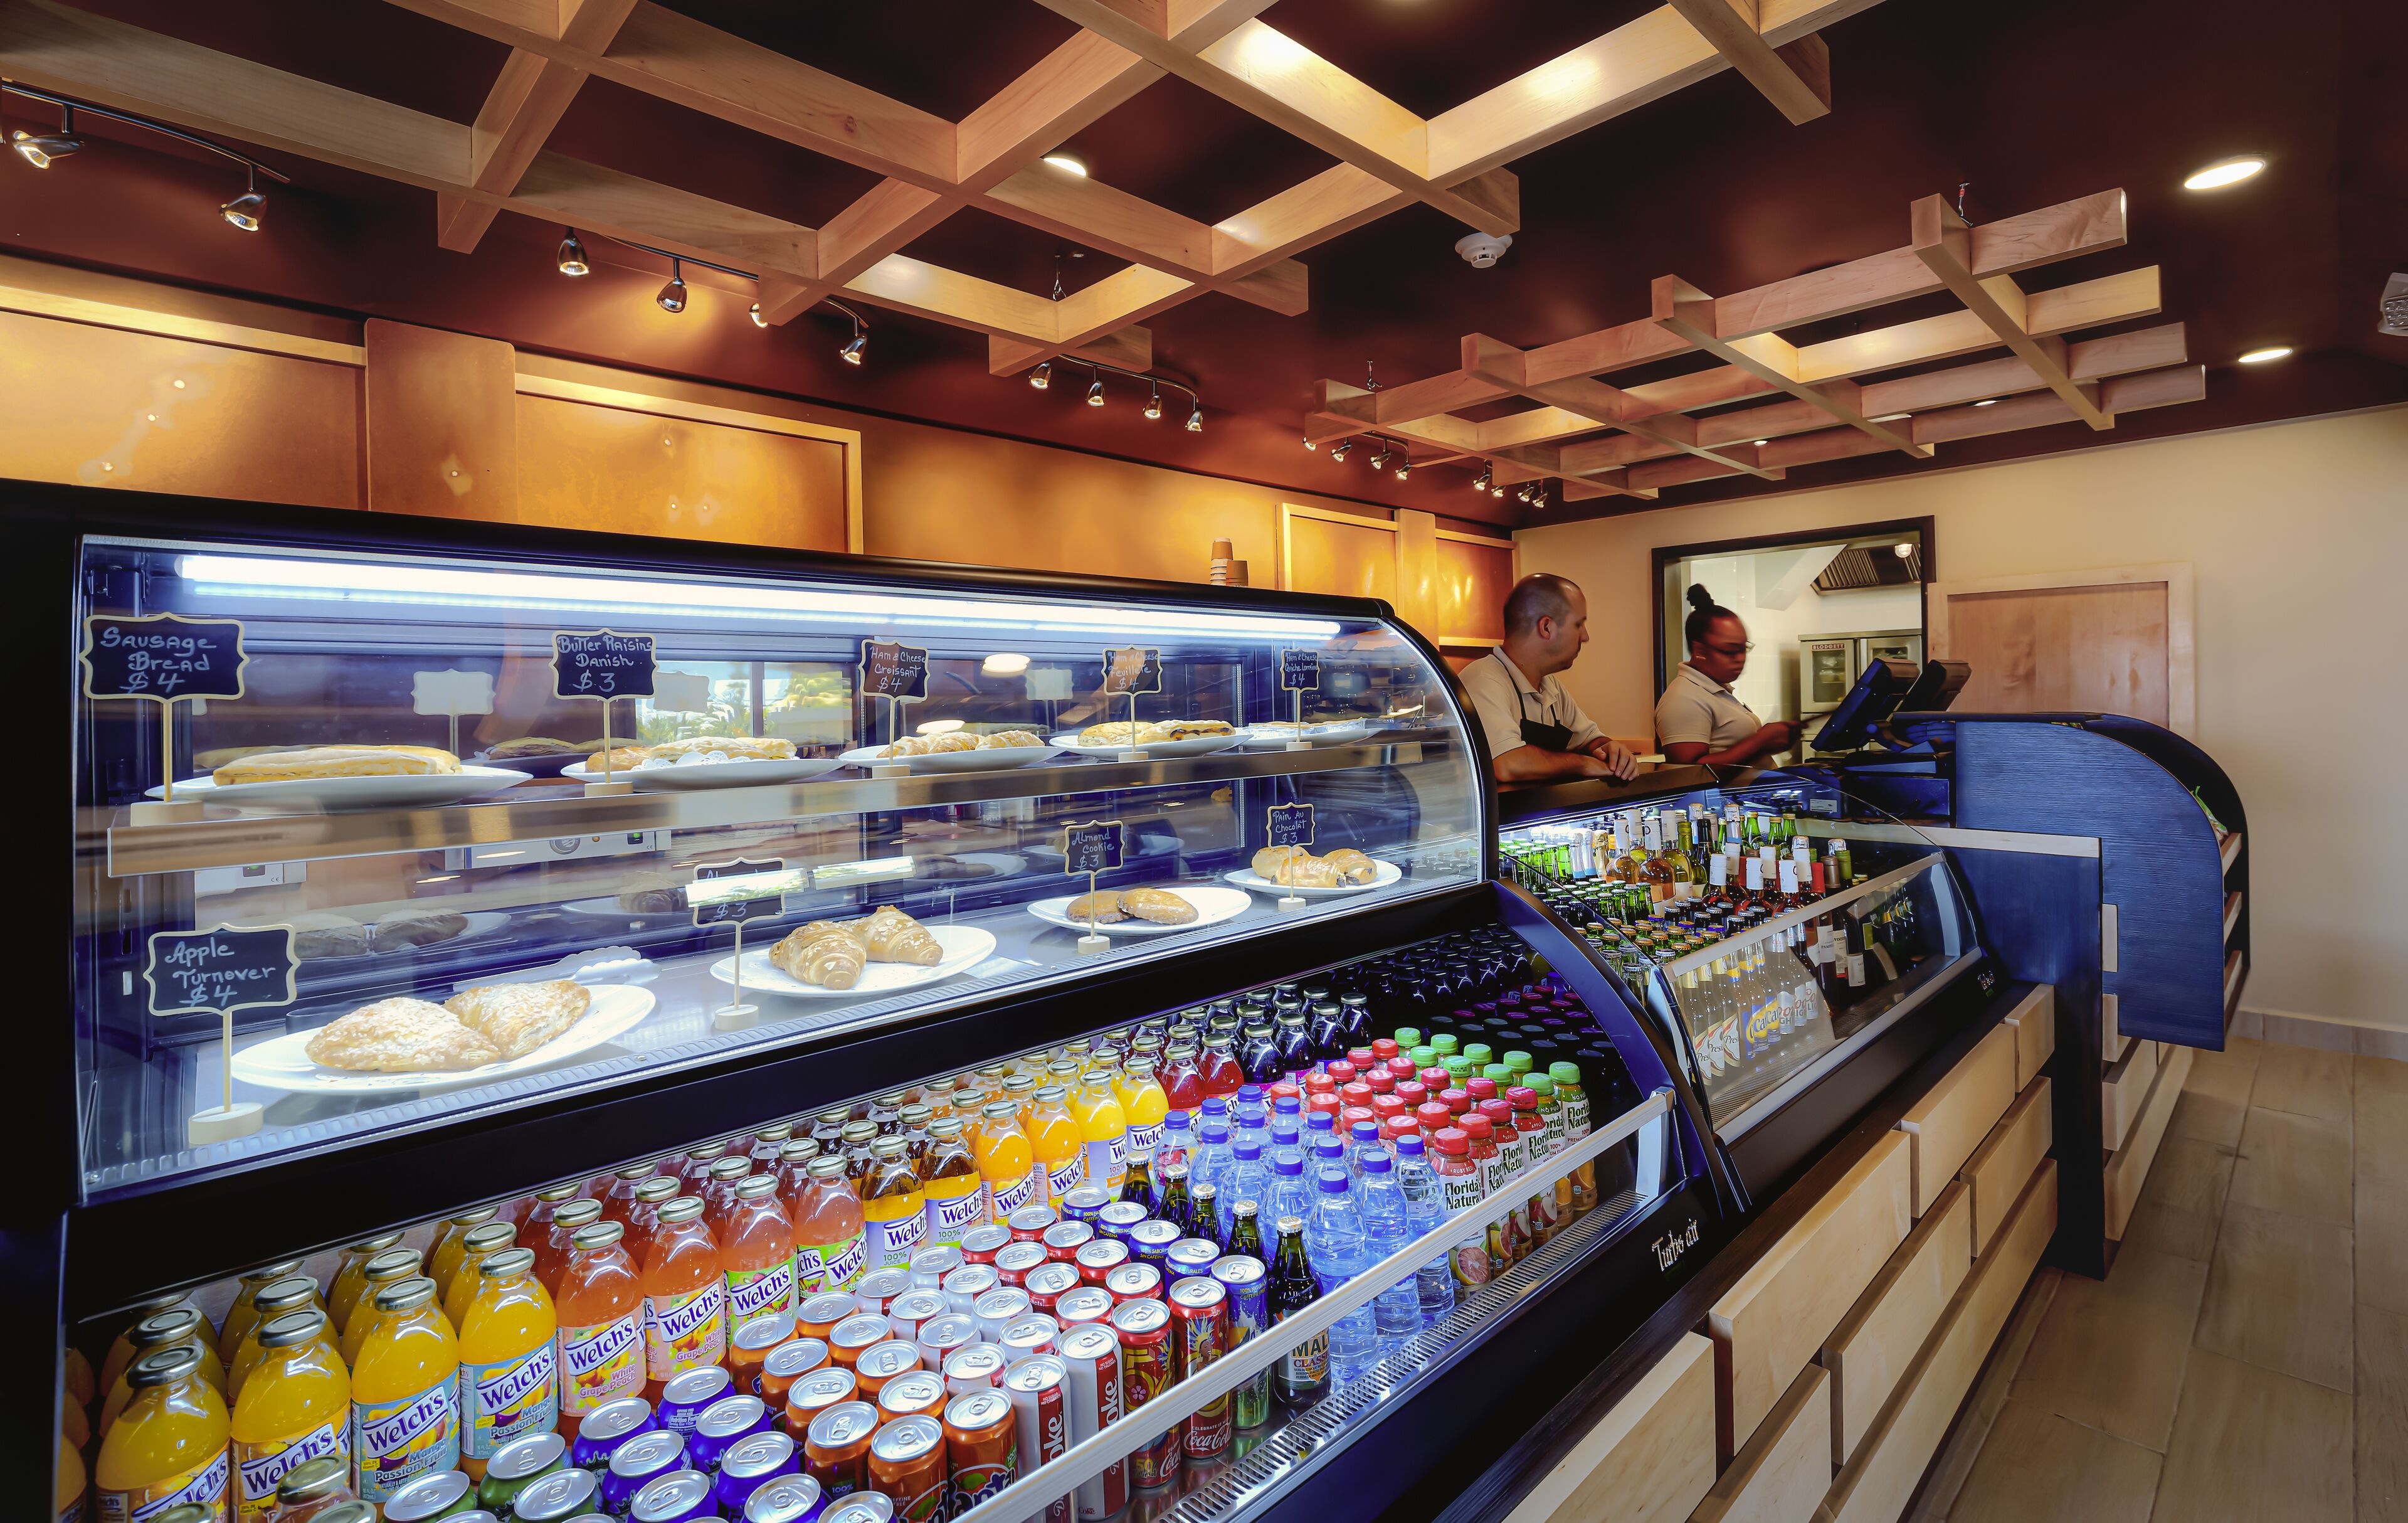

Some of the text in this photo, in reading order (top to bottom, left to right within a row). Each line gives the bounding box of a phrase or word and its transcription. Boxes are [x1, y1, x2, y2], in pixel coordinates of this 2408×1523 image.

[100, 626, 217, 656] Sausage
[602, 635, 652, 652] Raisins
[128, 651, 210, 672] Bread
[576, 653, 634, 667] Danish
[870, 647, 890, 660] Ham
[900, 651, 926, 663] Cheese
[1107, 652, 1127, 662] Ham
[874, 663, 921, 677] Croissant
[1272, 811, 1292, 823] Pain
[1275, 819, 1307, 833] Chocolat
[1071, 827, 1111, 846] Almond
[1082, 842, 1114, 854] Cookie
[164, 937, 235, 967] Apple
[172, 967, 277, 989] Turnover
[939, 1229, 961, 1239] 100%
[884, 1251, 907, 1261] 100%
[734, 1270, 789, 1311] Welch's
[662, 1289, 719, 1336] Welch's
[568, 1323, 633, 1370] Welch's
[677, 1347, 704, 1362] Grape
[480, 1352, 550, 1409] Welch's
[611, 1364, 636, 1381] White
[579, 1372, 636, 1398] Grape Peach
[521, 1395, 552, 1419] Mango
[366, 1394, 445, 1451] Welch's
[490, 1418, 532, 1438] Passion
[408, 1439, 446, 1463] Mango
[244, 1431, 334, 1494] Welch's
[374, 1461, 424, 1483] Passion
[832, 1483, 853, 1494] 100%
[1078, 1507, 1096, 1515] Coke
